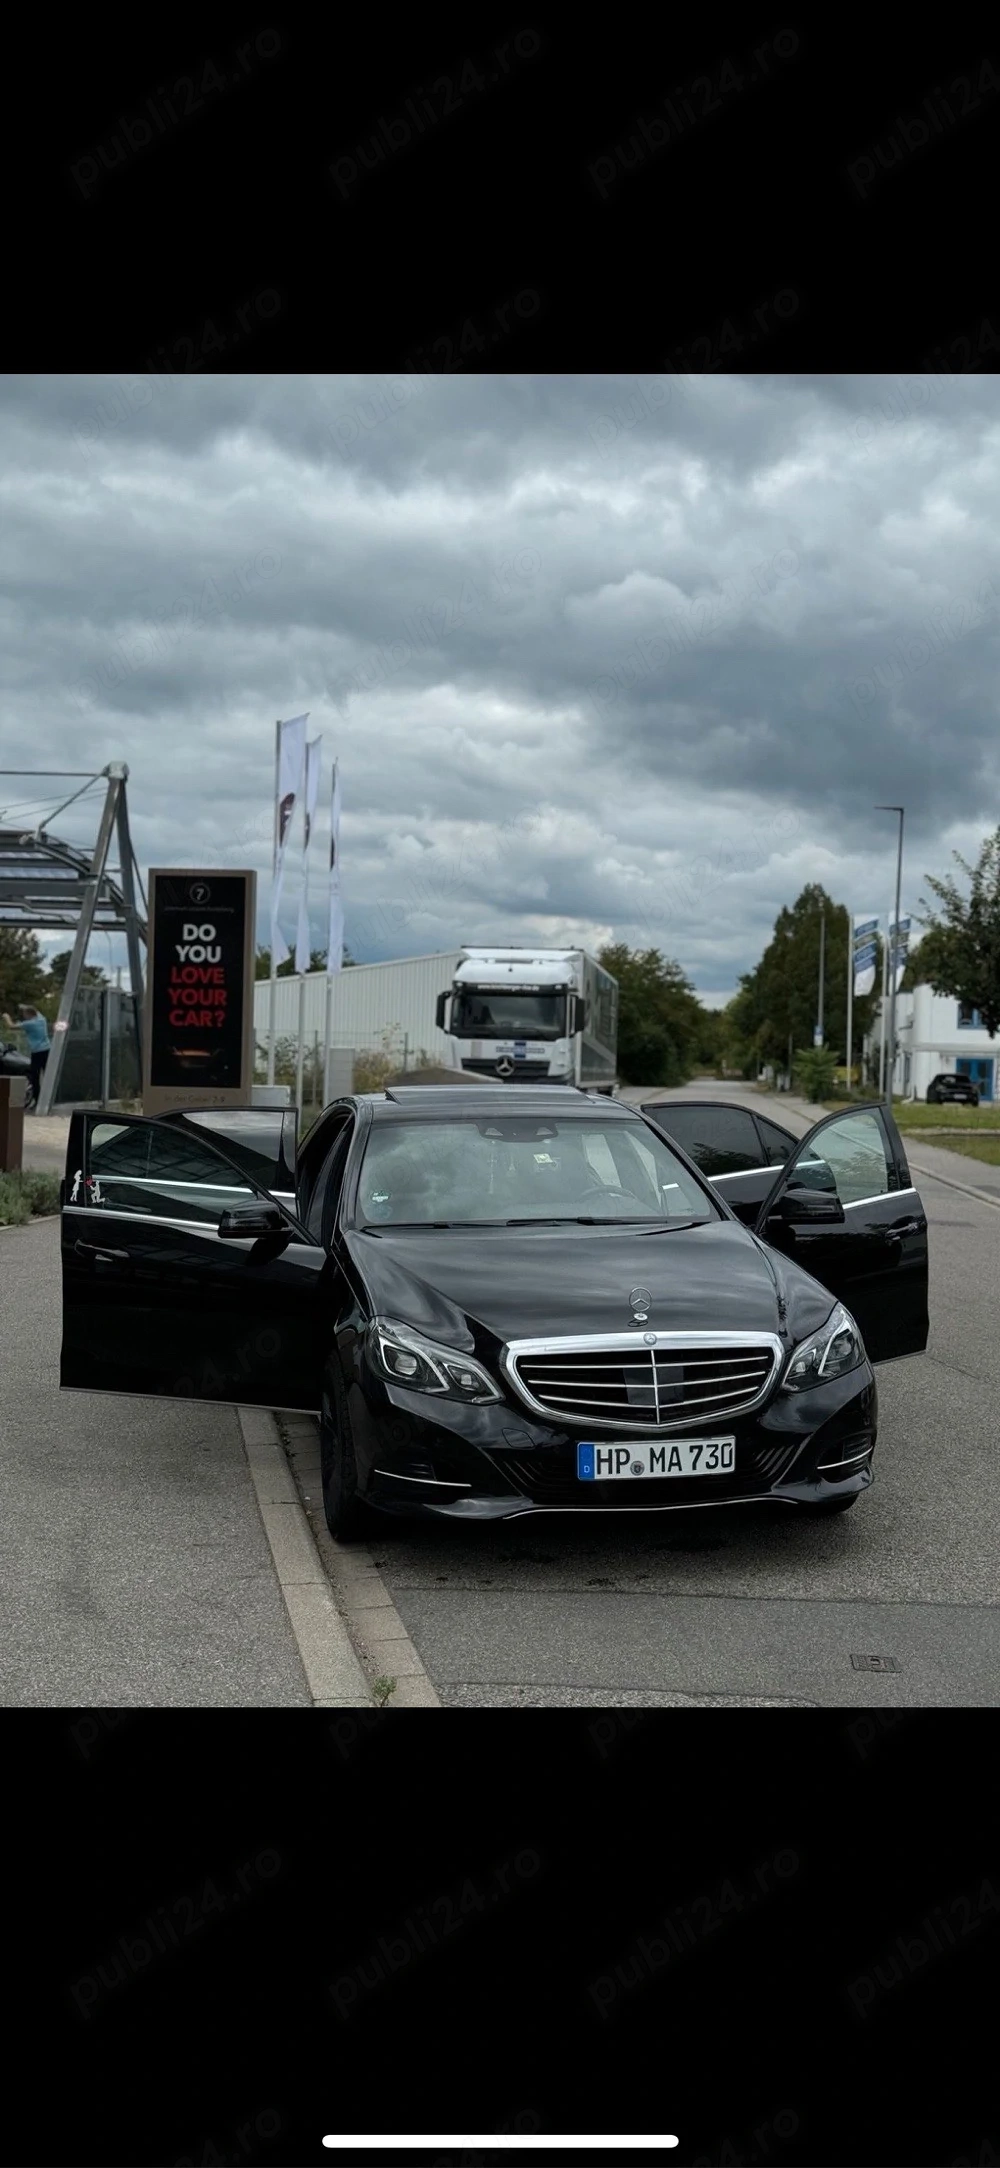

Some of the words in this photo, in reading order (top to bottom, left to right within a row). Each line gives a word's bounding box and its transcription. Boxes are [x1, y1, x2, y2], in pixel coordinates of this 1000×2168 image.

[182, 923, 216, 941] DO
[175, 945, 222, 963] YOU
[171, 967, 225, 984] LOVE
[168, 988, 227, 1006] YOUR
[169, 1010, 226, 1027] CAR?
[583, 1465, 590, 1473] D
[596, 1448, 631, 1475] HP
[650, 1446, 683, 1473] MA
[689, 1442, 733, 1471] 730
